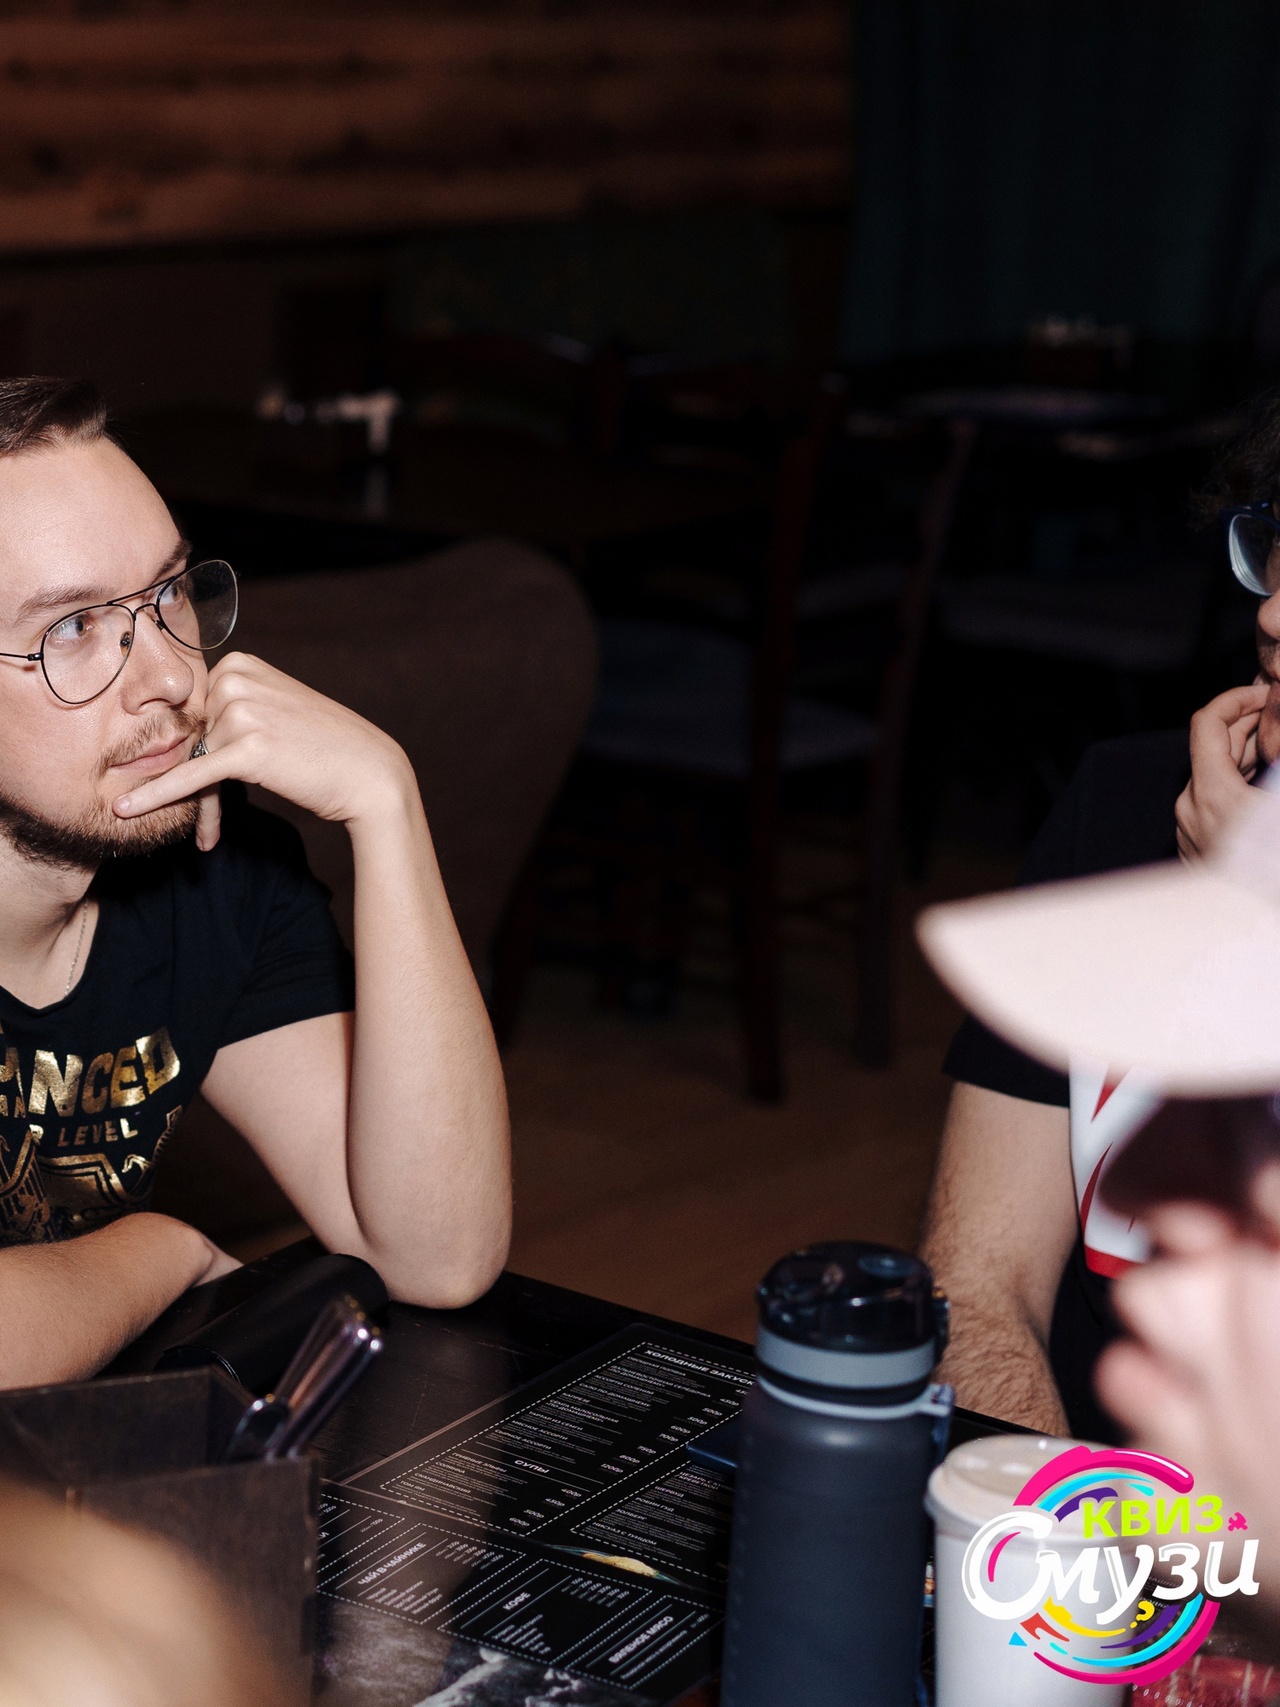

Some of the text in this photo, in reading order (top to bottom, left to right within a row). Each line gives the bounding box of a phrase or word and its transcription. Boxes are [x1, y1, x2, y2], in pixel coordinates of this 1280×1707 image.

[57, 1117, 139, 1147] LEVEL
[644, 1349, 710, 1372] ХОЛОДНЫЕ
[710, 1369, 755, 1386] ЗАКУСК
[514, 1459, 550, 1474] СУПЫ
[502, 1591, 531, 1611] КОФЕ
